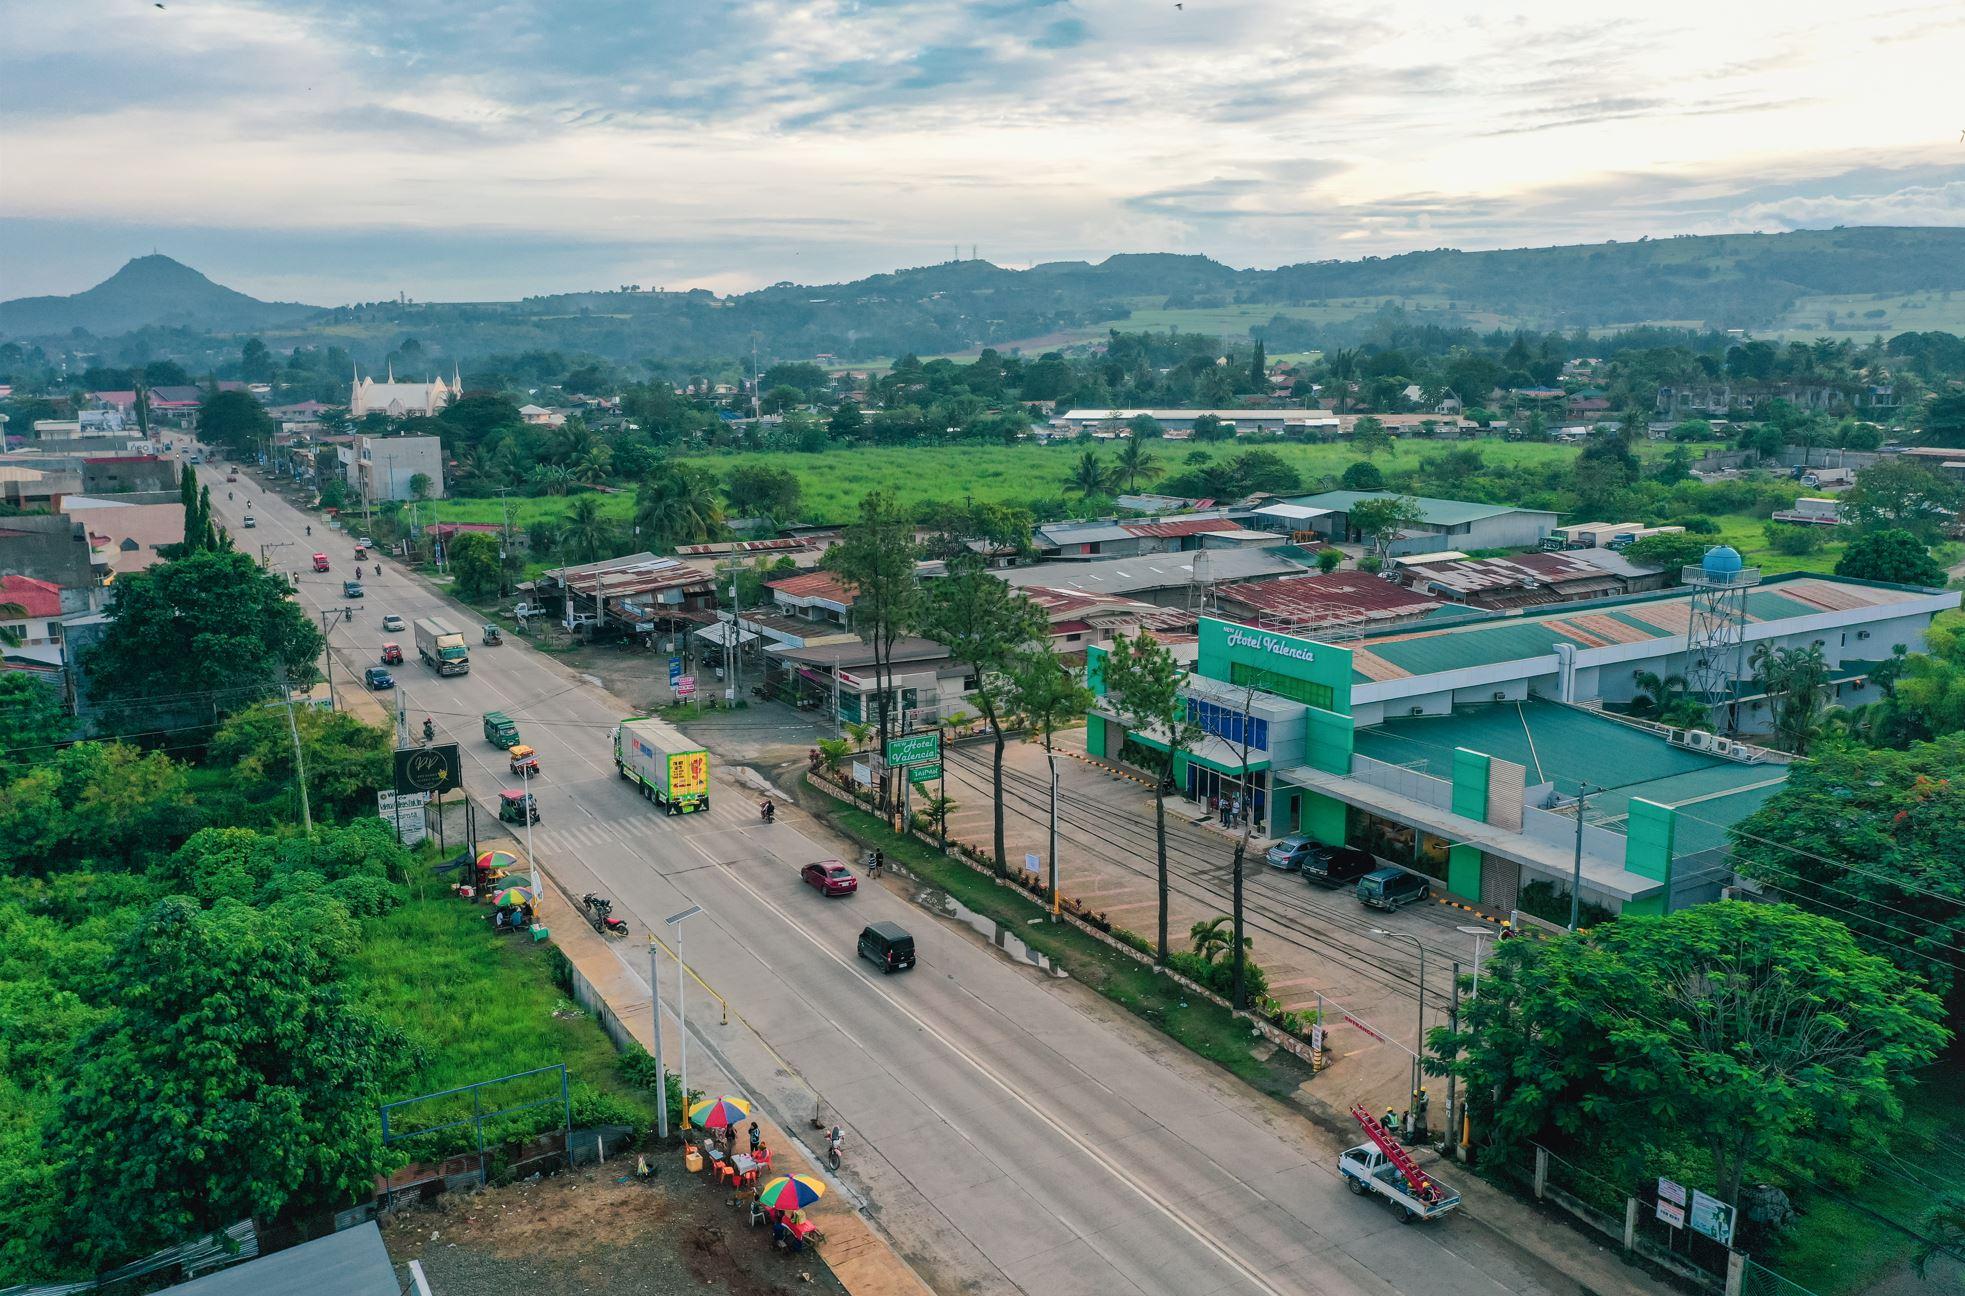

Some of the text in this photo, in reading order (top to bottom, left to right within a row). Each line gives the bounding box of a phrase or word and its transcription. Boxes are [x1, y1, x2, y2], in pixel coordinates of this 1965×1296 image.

[1227, 629, 1262, 650] Hotel
[1263, 636, 1314, 662] Valencia
[903, 737, 934, 753] Hotel
[892, 749, 935, 763] Valencia
